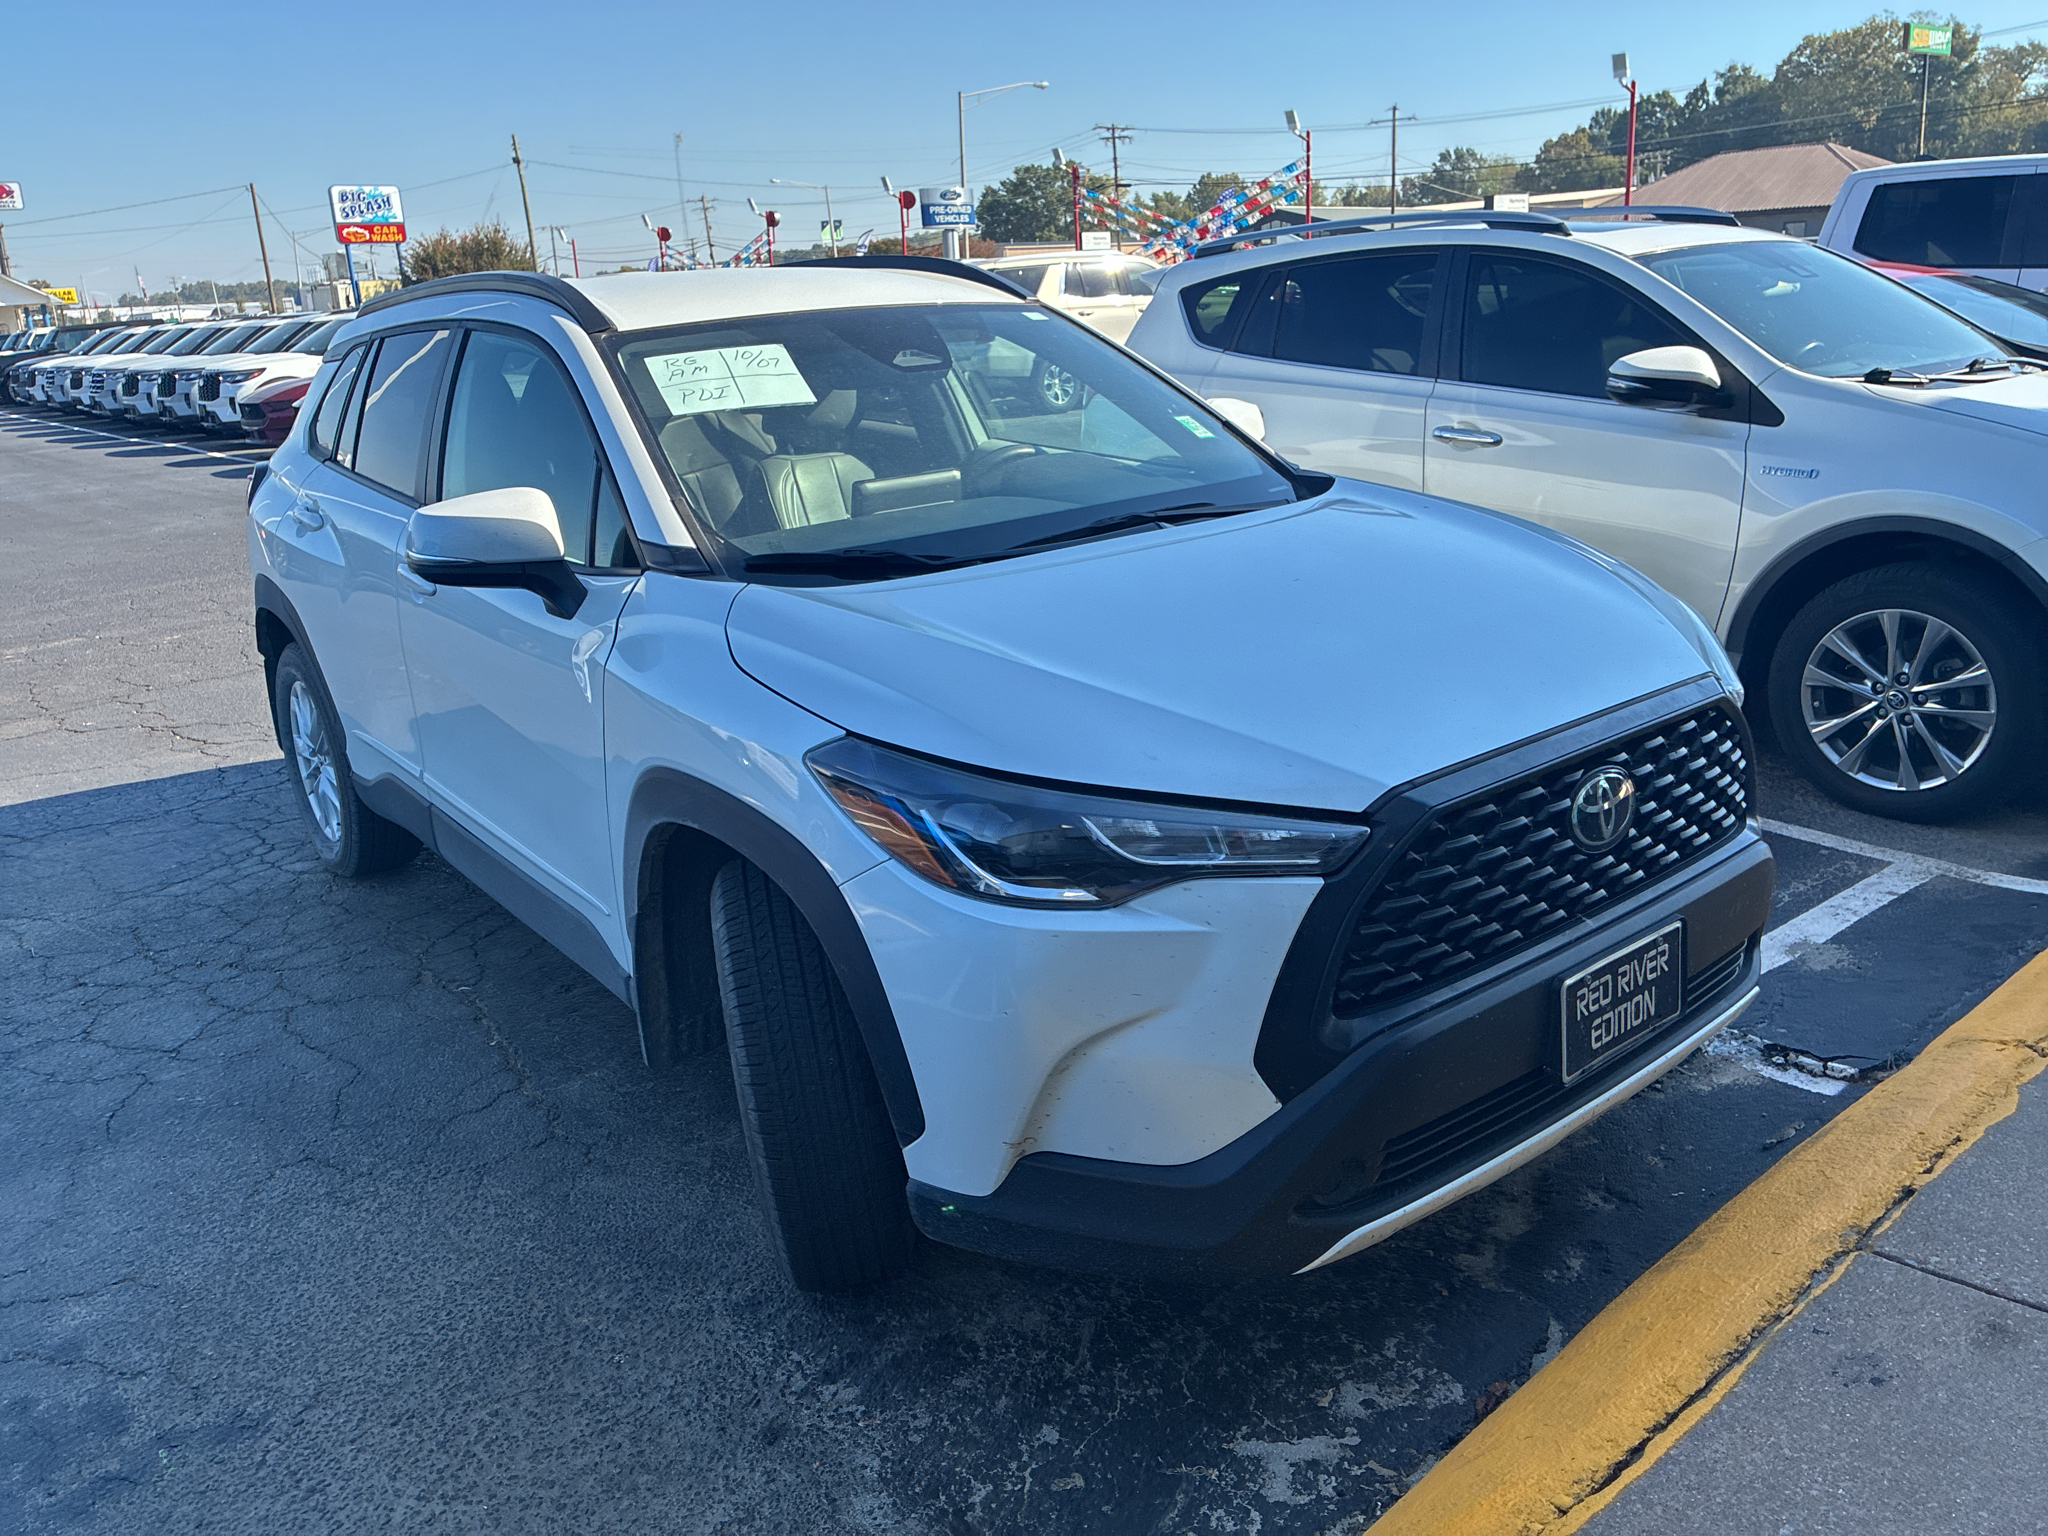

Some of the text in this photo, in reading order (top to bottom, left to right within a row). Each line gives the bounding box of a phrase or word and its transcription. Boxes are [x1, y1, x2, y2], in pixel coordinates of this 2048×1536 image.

[339, 189, 367, 204] BIG
[340, 195, 392, 218] SPLASH
[929, 205, 972, 214] PRE-OWNED
[934, 214, 970, 223] VEHICLES
[373, 225, 398, 234] CAR
[370, 233, 403, 242] WASH
[664, 356, 698, 370] RG
[734, 349, 780, 368] 10/07
[679, 385, 732, 405] PDI
[1576, 943, 1669, 1021] RED RIVER
[1591, 986, 1656, 1050] EDITION
